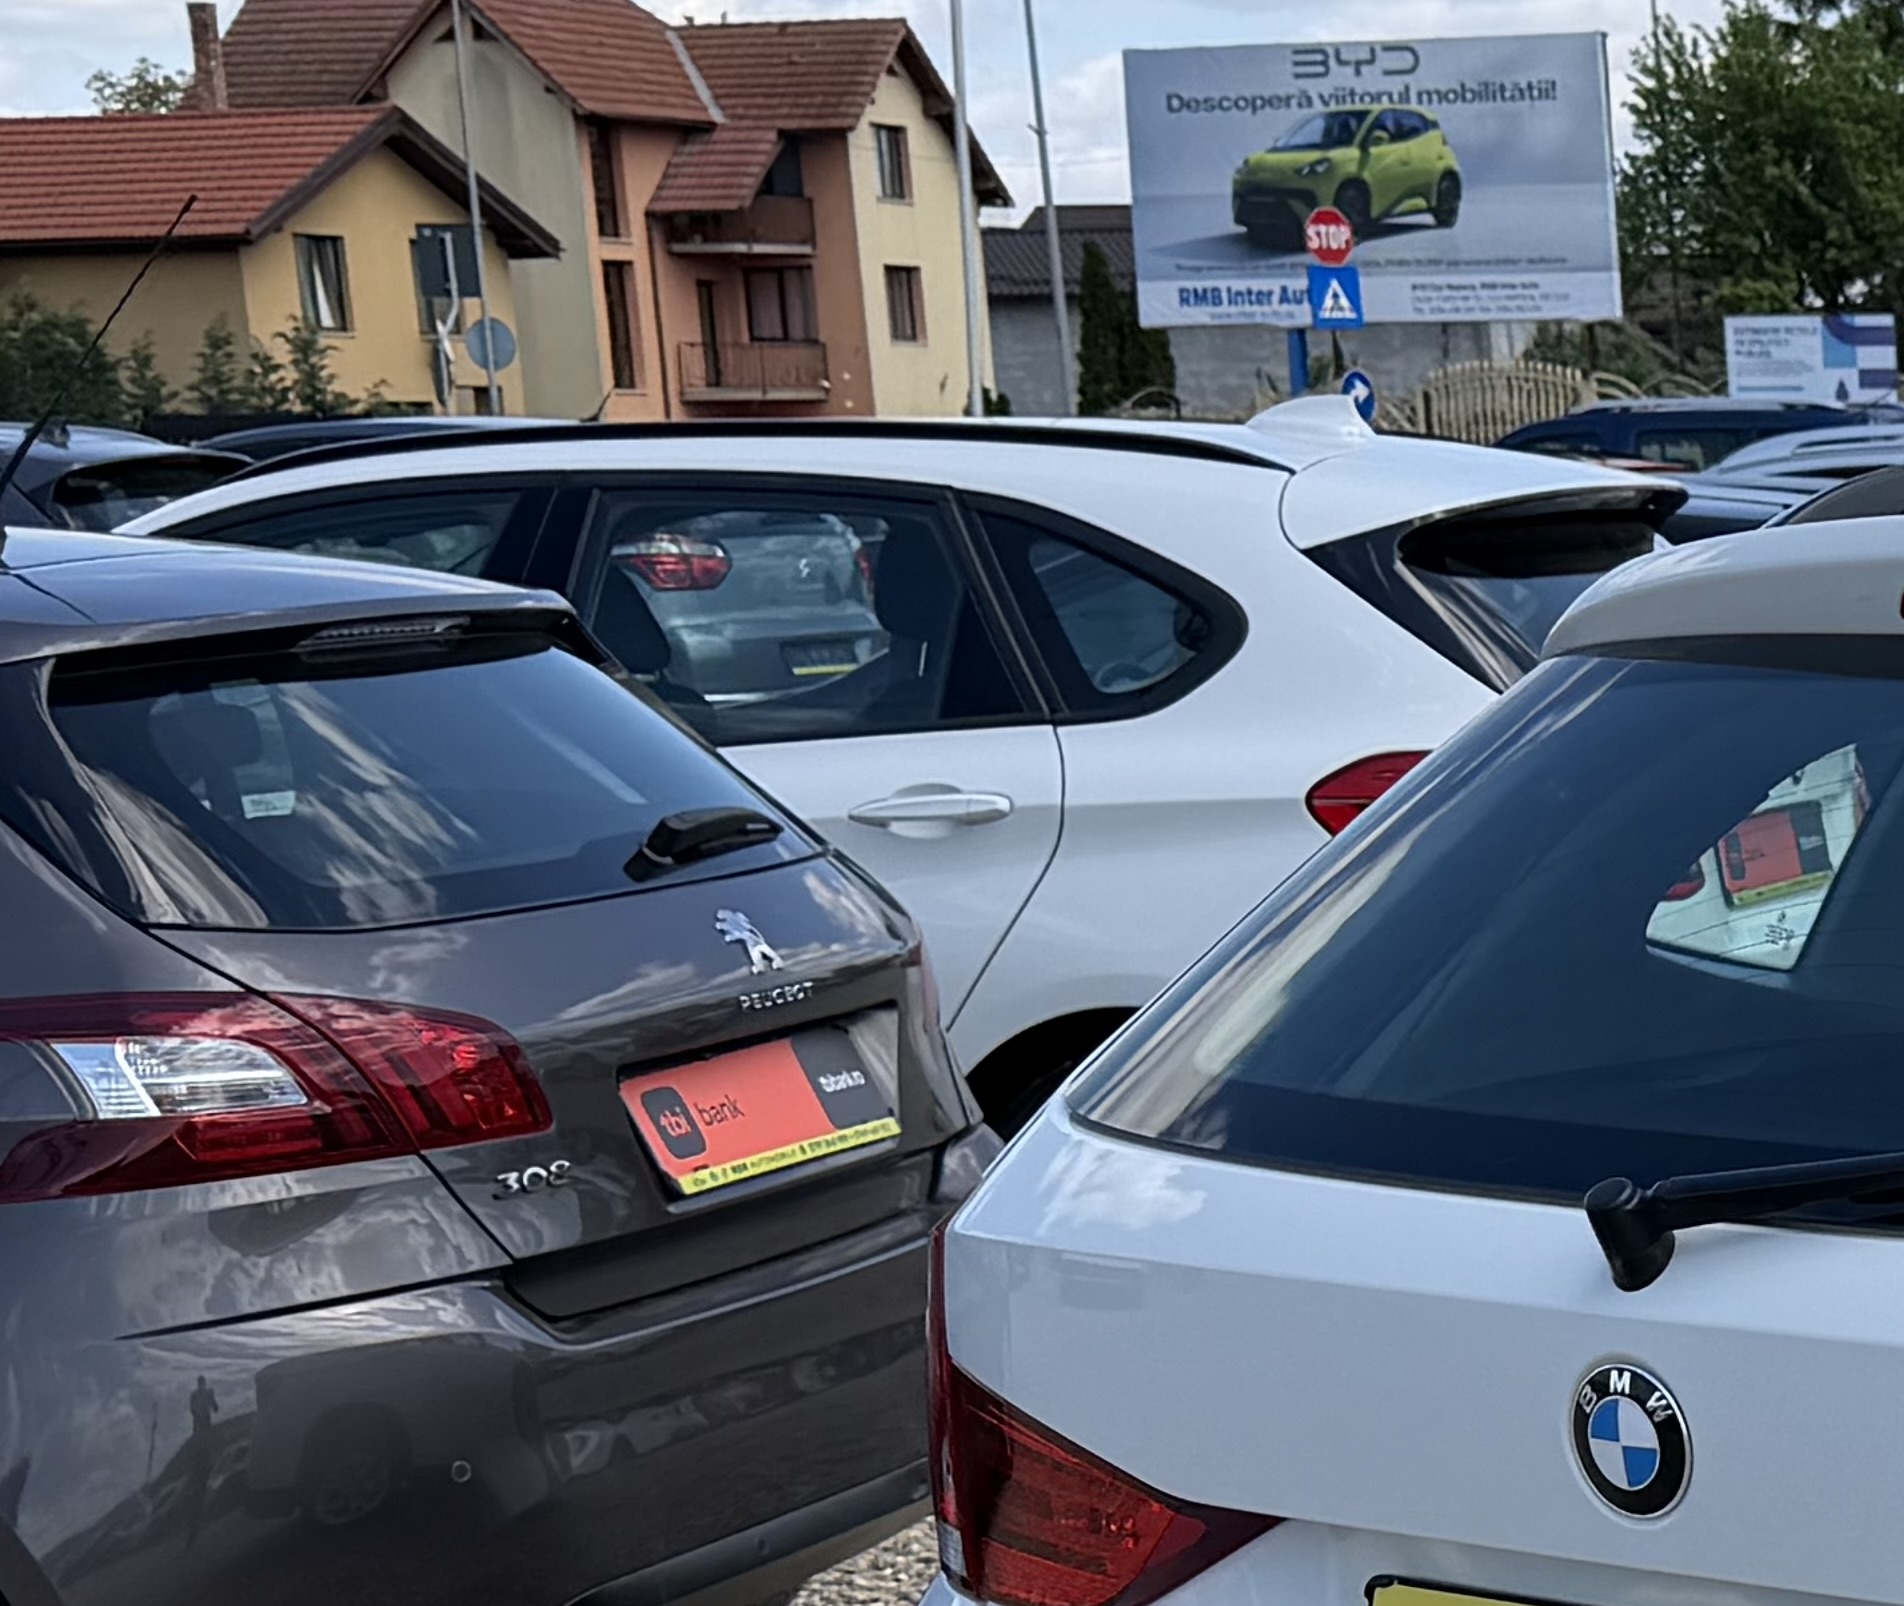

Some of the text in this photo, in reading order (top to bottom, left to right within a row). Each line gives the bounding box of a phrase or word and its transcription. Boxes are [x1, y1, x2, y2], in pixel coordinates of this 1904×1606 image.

[1291, 45, 1420, 80] BYD
[1165, 88, 1313, 117] Descoperă
[1318, 84, 1411, 107] viitorul
[1306, 223, 1352, 251] STOP
[1178, 286, 1224, 308] RMB
[1227, 285, 1274, 307] Inter
[737, 980, 815, 1011] PEUGEOT
[660, 1094, 745, 1138] tbi bank
[493, 1159, 571, 1198] 308
[1579, 1369, 1674, 1423] BMW
